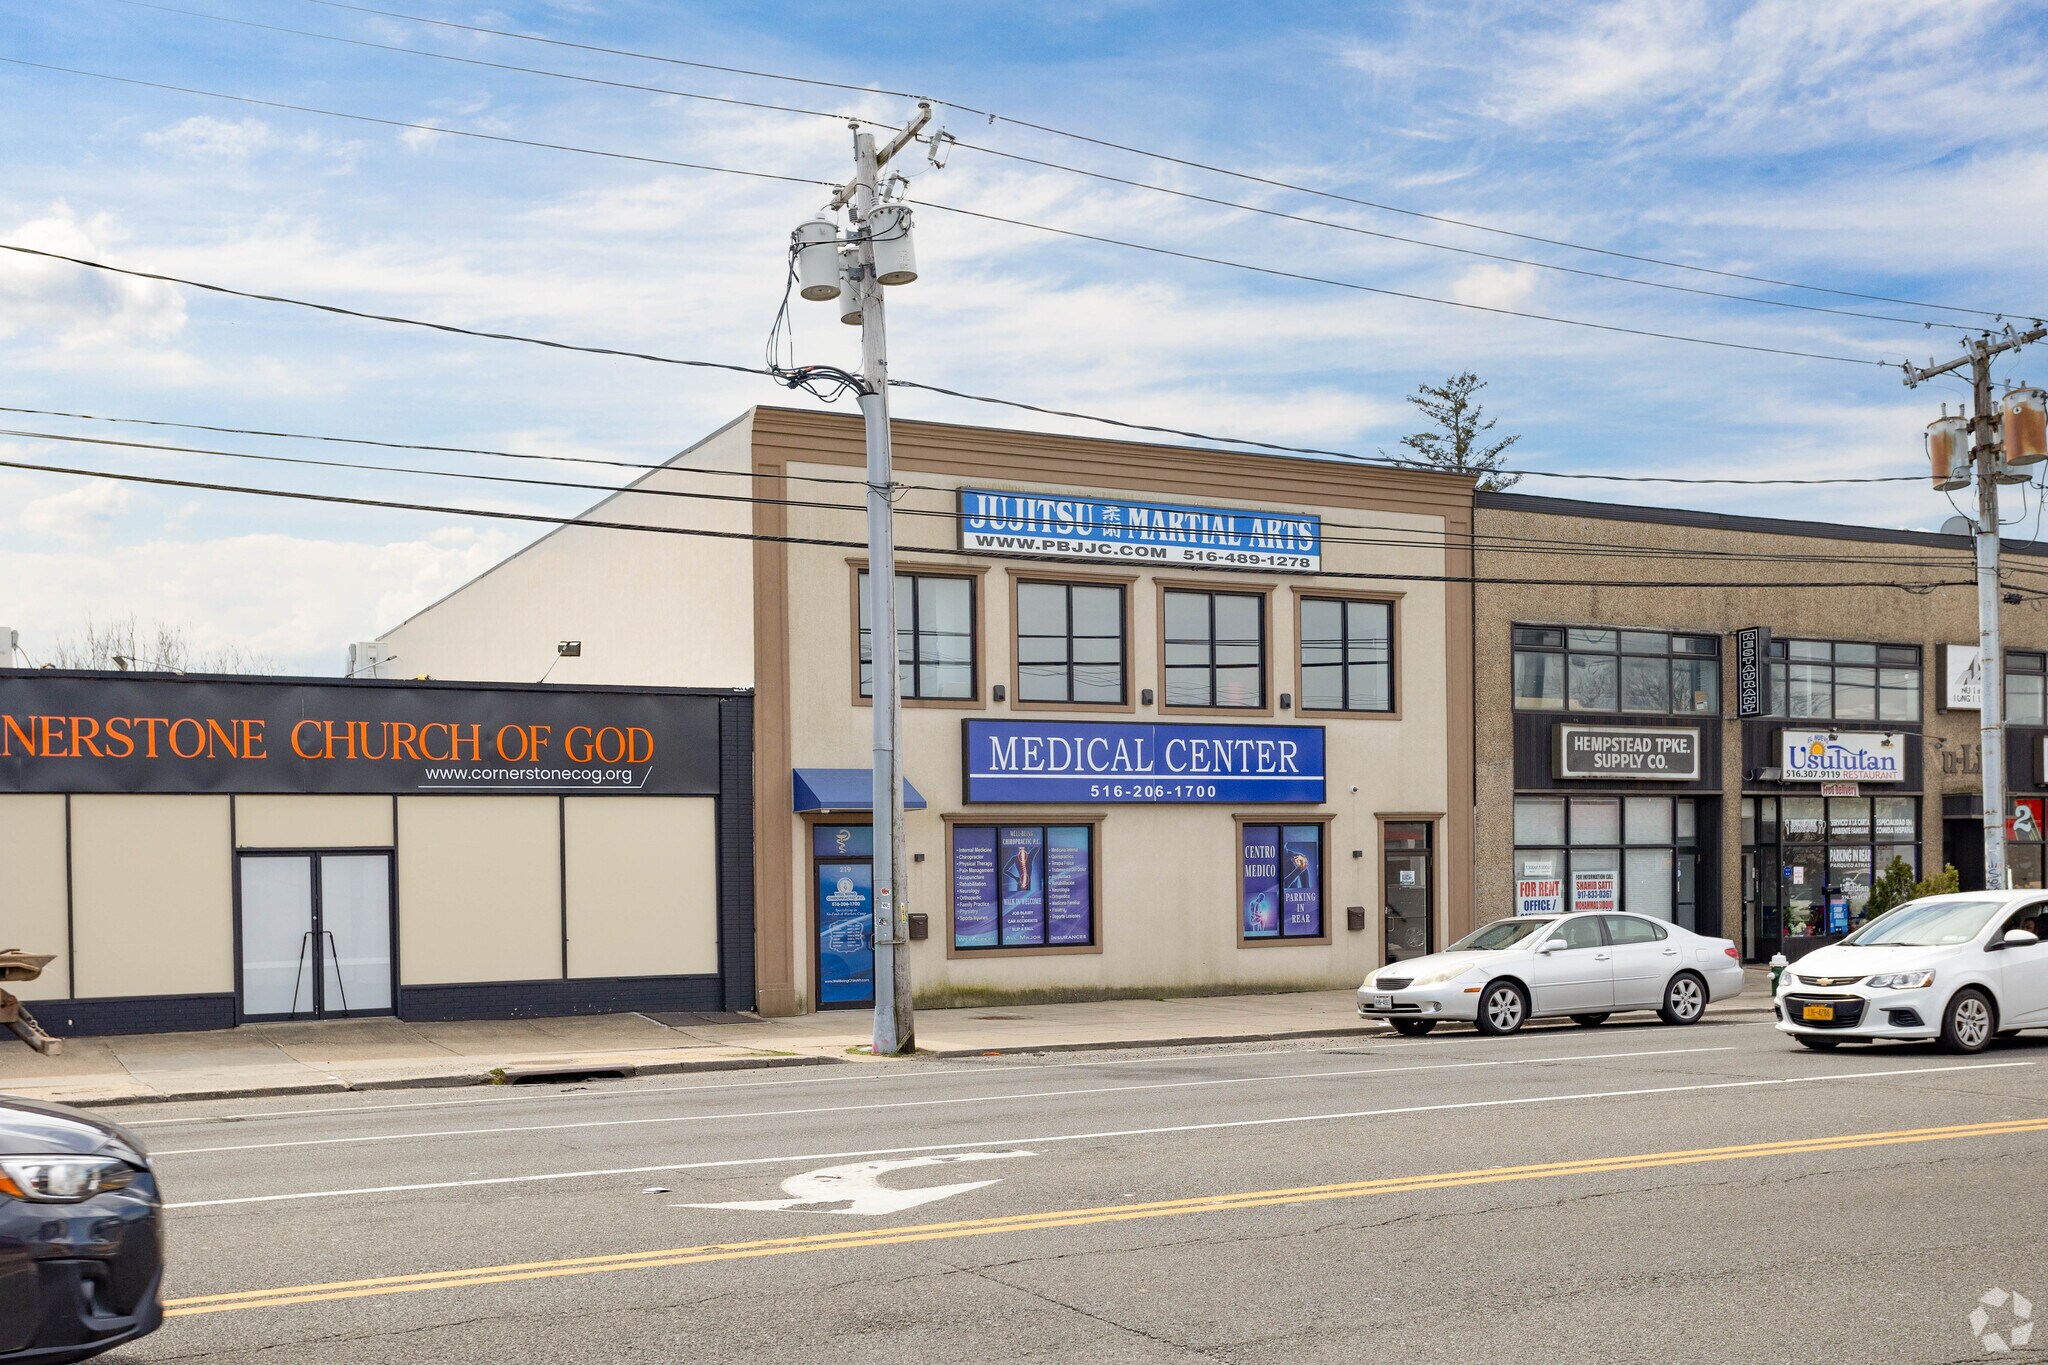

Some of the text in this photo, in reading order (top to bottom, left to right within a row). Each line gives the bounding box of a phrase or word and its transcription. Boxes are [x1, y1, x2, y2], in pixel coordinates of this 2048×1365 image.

[970, 495, 1313, 552] JUJITSU MARTIAL ARTS
[975, 535, 1311, 568] WWW.PBJJC.COM 516-489-1278
[1742, 632, 1756, 712] RESTAURANT
[0, 714, 654, 763] NERSTONE CHURCH OF GOD
[1574, 736, 1690, 754] HEMPSTEAD TPKE.
[989, 736, 1300, 774] MEDICAL CENTER
[1594, 753, 1668, 769] SUPPLY CO.
[1789, 745, 1896, 771] Usulutan
[424, 766, 632, 784] www.cornerstonecog.org
[1786, 770, 1898, 779] 516.307.9119 RESTAURANT
[1090, 785, 1217, 798] 516-206-1700
[1244, 846, 1276, 858] CENTRO
[1830, 849, 1852, 862] PARKING
[1852, 849, 1858, 862] IN
[1245, 865, 1276, 877] MEDICO
[1520, 881, 1560, 897] FOR RENT
[1576, 881, 1613, 890] SHAHID SATTI
[1285, 892, 1316, 902] PARKING
[1296, 904, 1304, 912] IN
[1524, 900, 1550, 911] OFFICE
[1292, 914, 1310, 923] REAR
